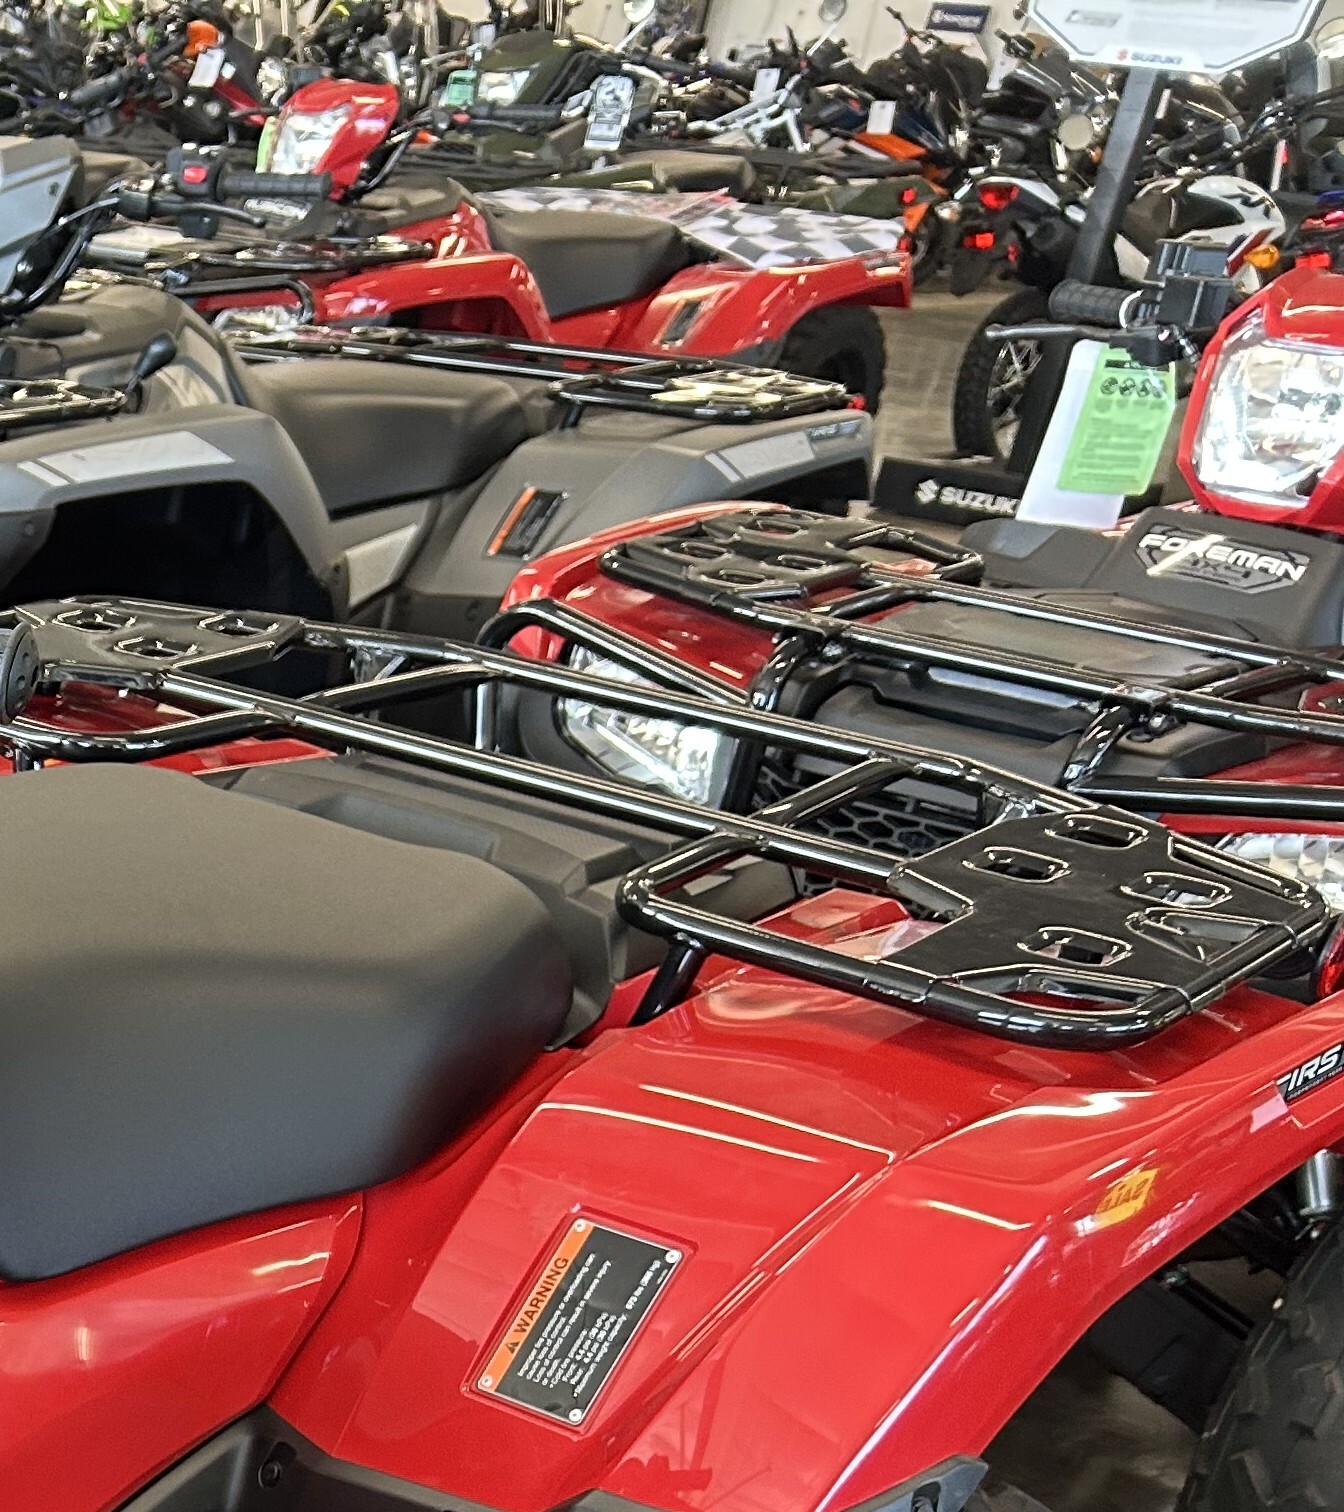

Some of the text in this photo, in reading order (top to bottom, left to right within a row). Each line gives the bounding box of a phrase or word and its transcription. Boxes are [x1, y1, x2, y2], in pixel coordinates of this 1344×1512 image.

[940, 486, 1018, 515] SUZUK
[1286, 1043, 1343, 1092] IRS
[513, 1257, 569, 1333] WARNING
